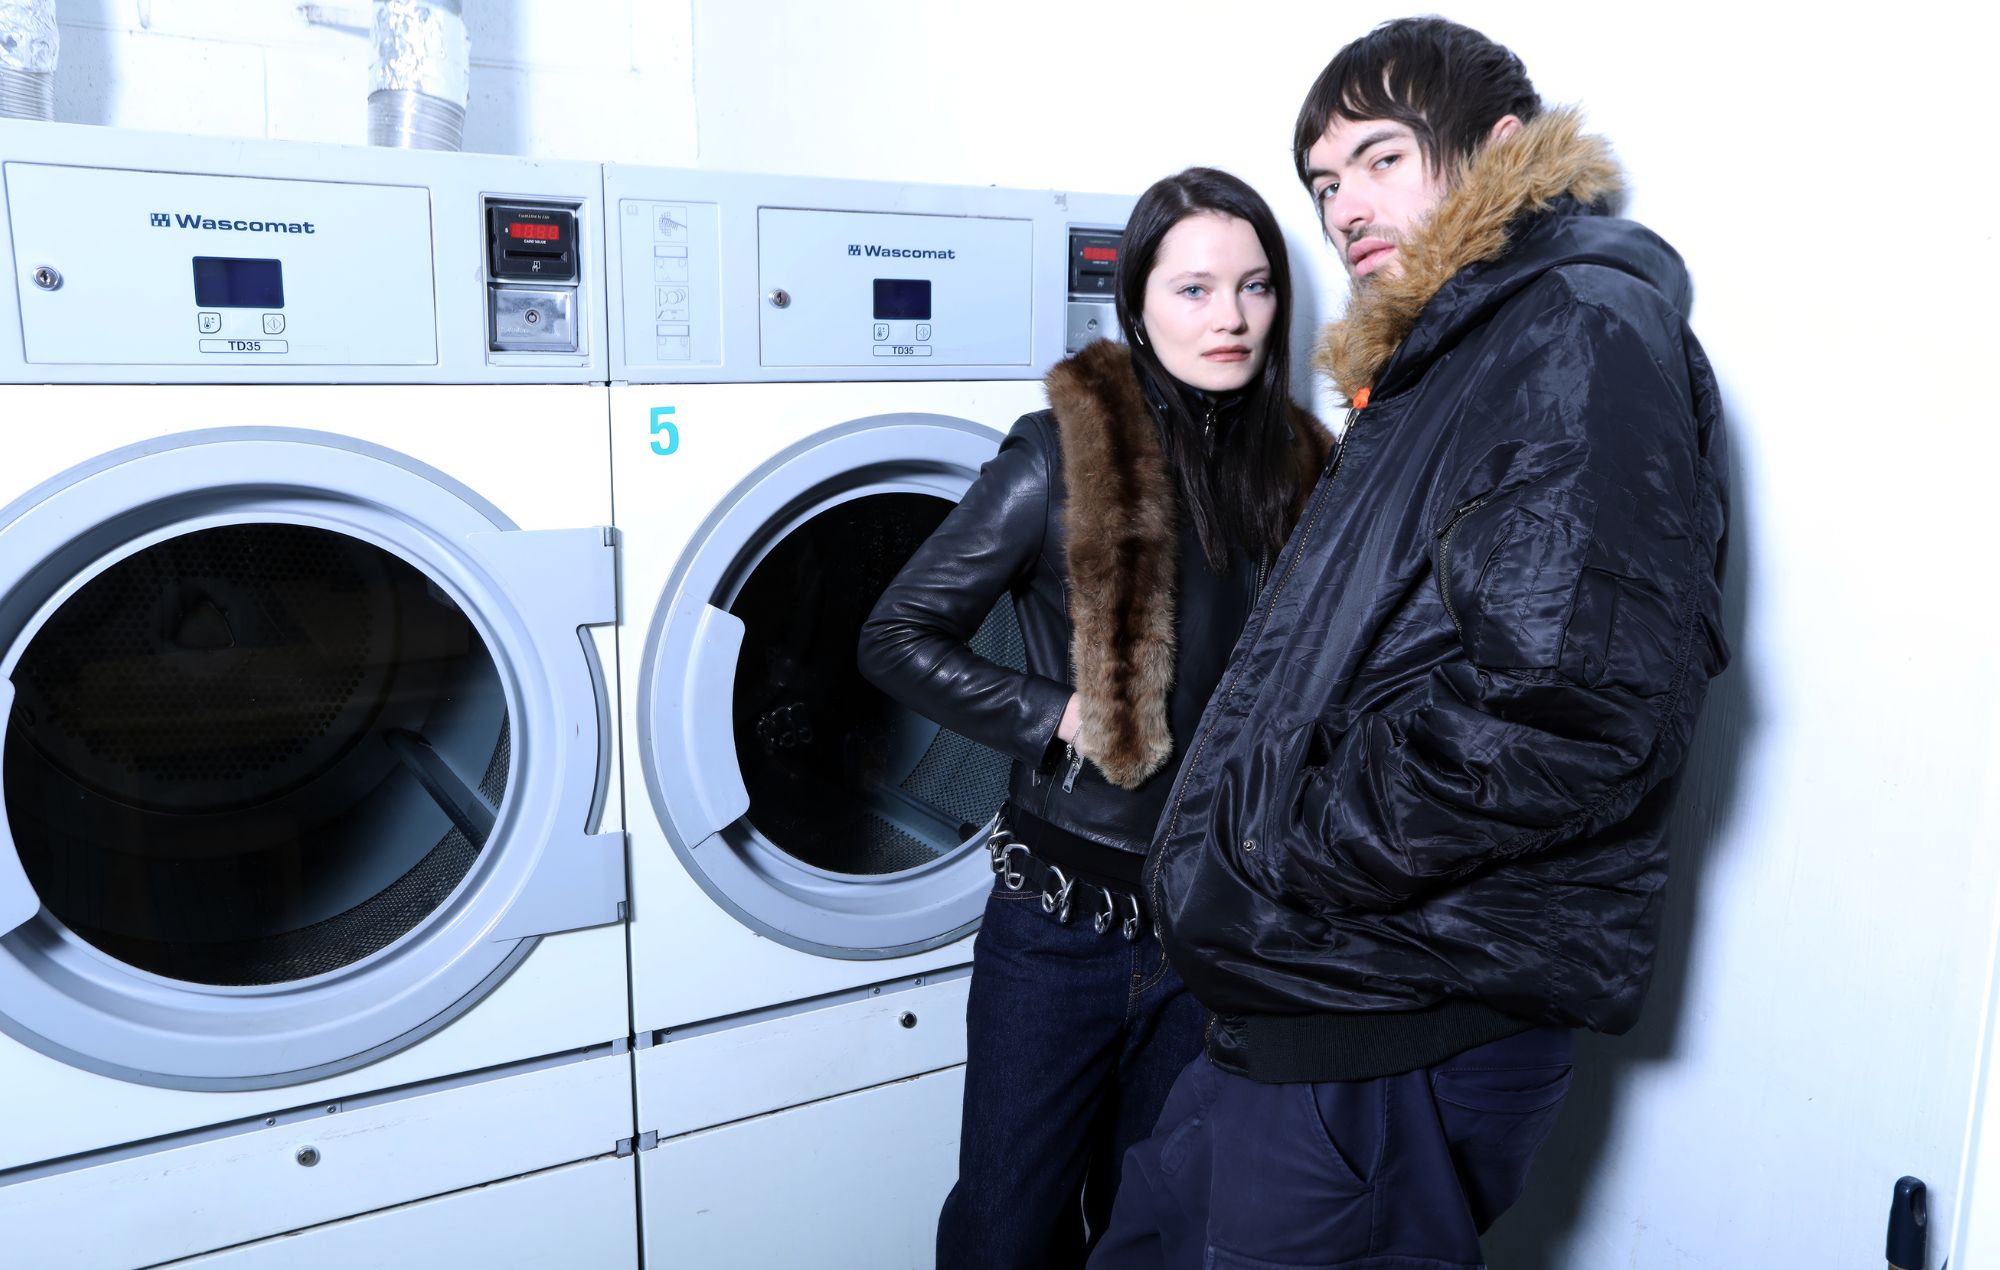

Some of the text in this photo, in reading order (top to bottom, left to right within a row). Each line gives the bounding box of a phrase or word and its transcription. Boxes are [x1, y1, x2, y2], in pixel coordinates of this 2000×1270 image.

[175, 213, 315, 234] Wascomat
[864, 244, 956, 260] Wascomat
[228, 340, 261, 352] TD35
[892, 346, 914, 355] TD35
[650, 406, 679, 456] 5
